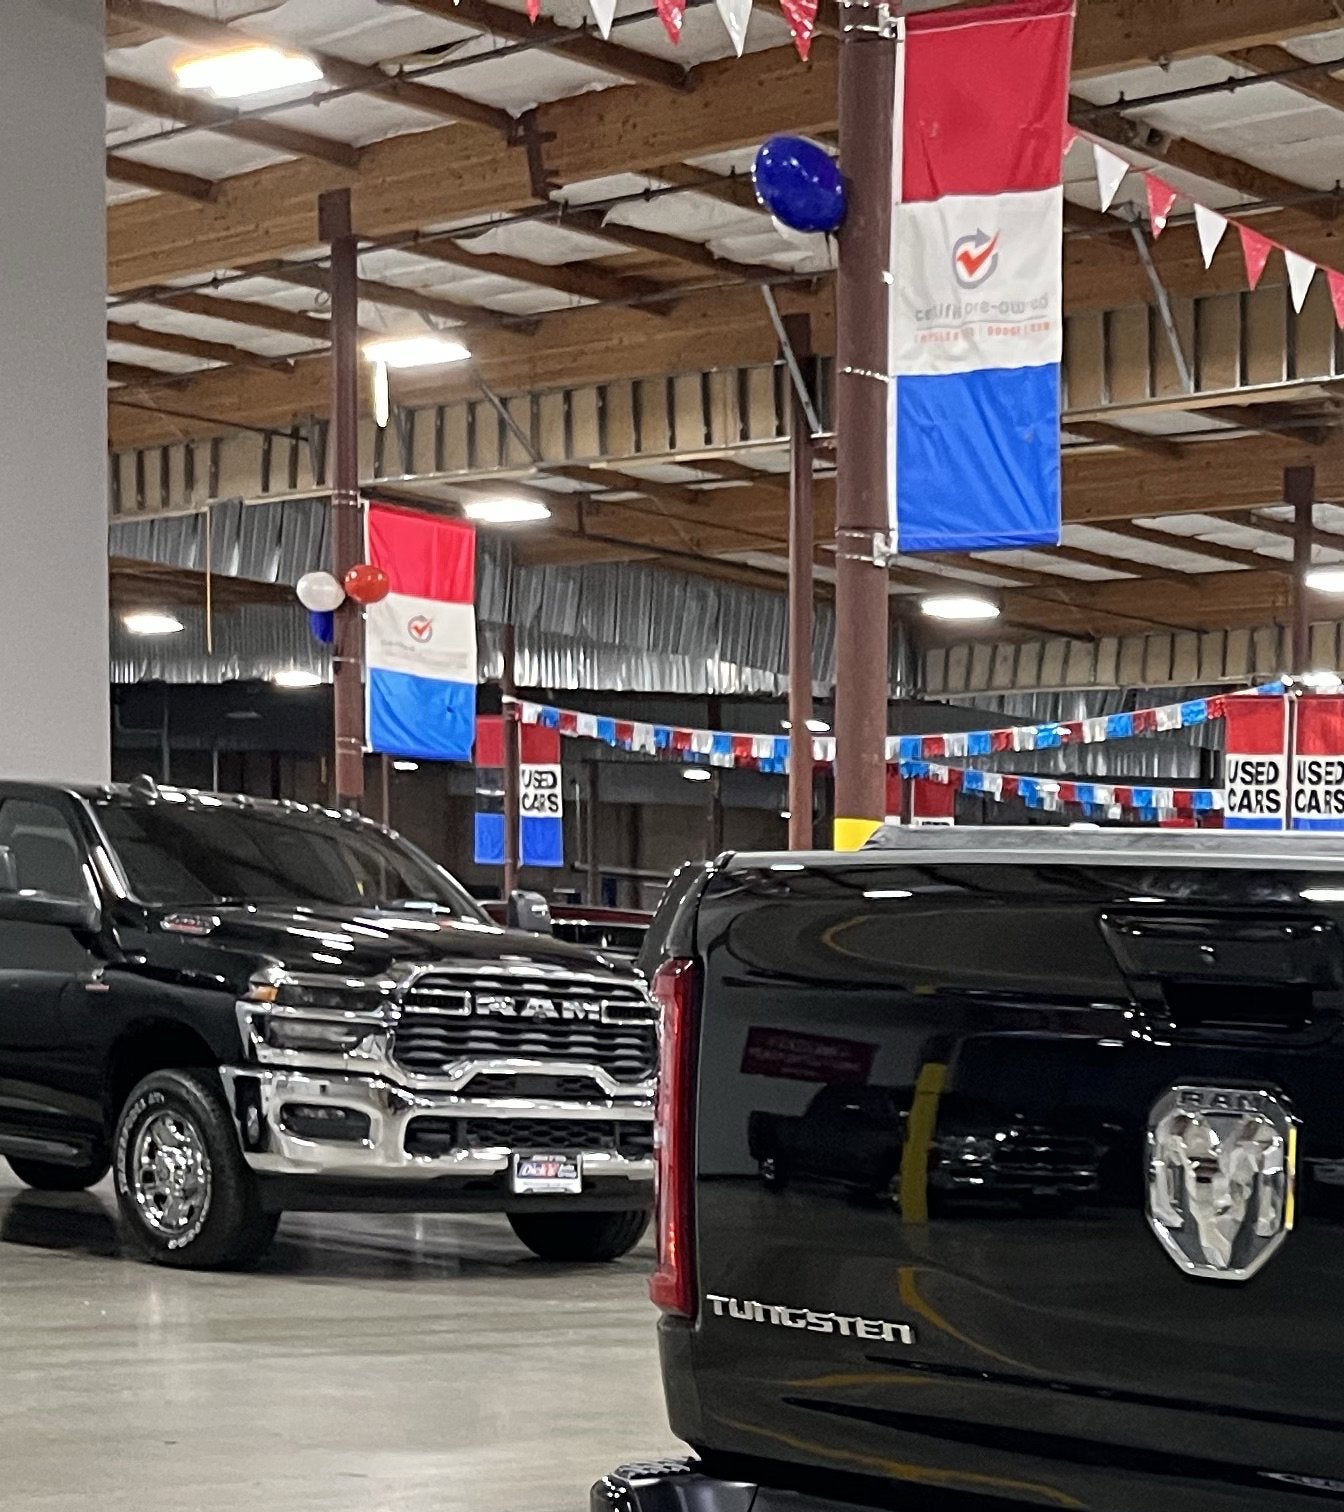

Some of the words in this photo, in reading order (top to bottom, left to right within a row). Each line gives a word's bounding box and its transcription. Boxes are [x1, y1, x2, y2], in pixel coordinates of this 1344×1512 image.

[521, 769, 557, 789] USED
[1228, 760, 1279, 785] USED
[521, 793, 559, 812] CARS
[1228, 788, 1281, 814] CARS
[475, 994, 600, 1020] RAM
[1182, 1091, 1263, 1112] RAM
[706, 1294, 916, 1344] TUNGSTEN
